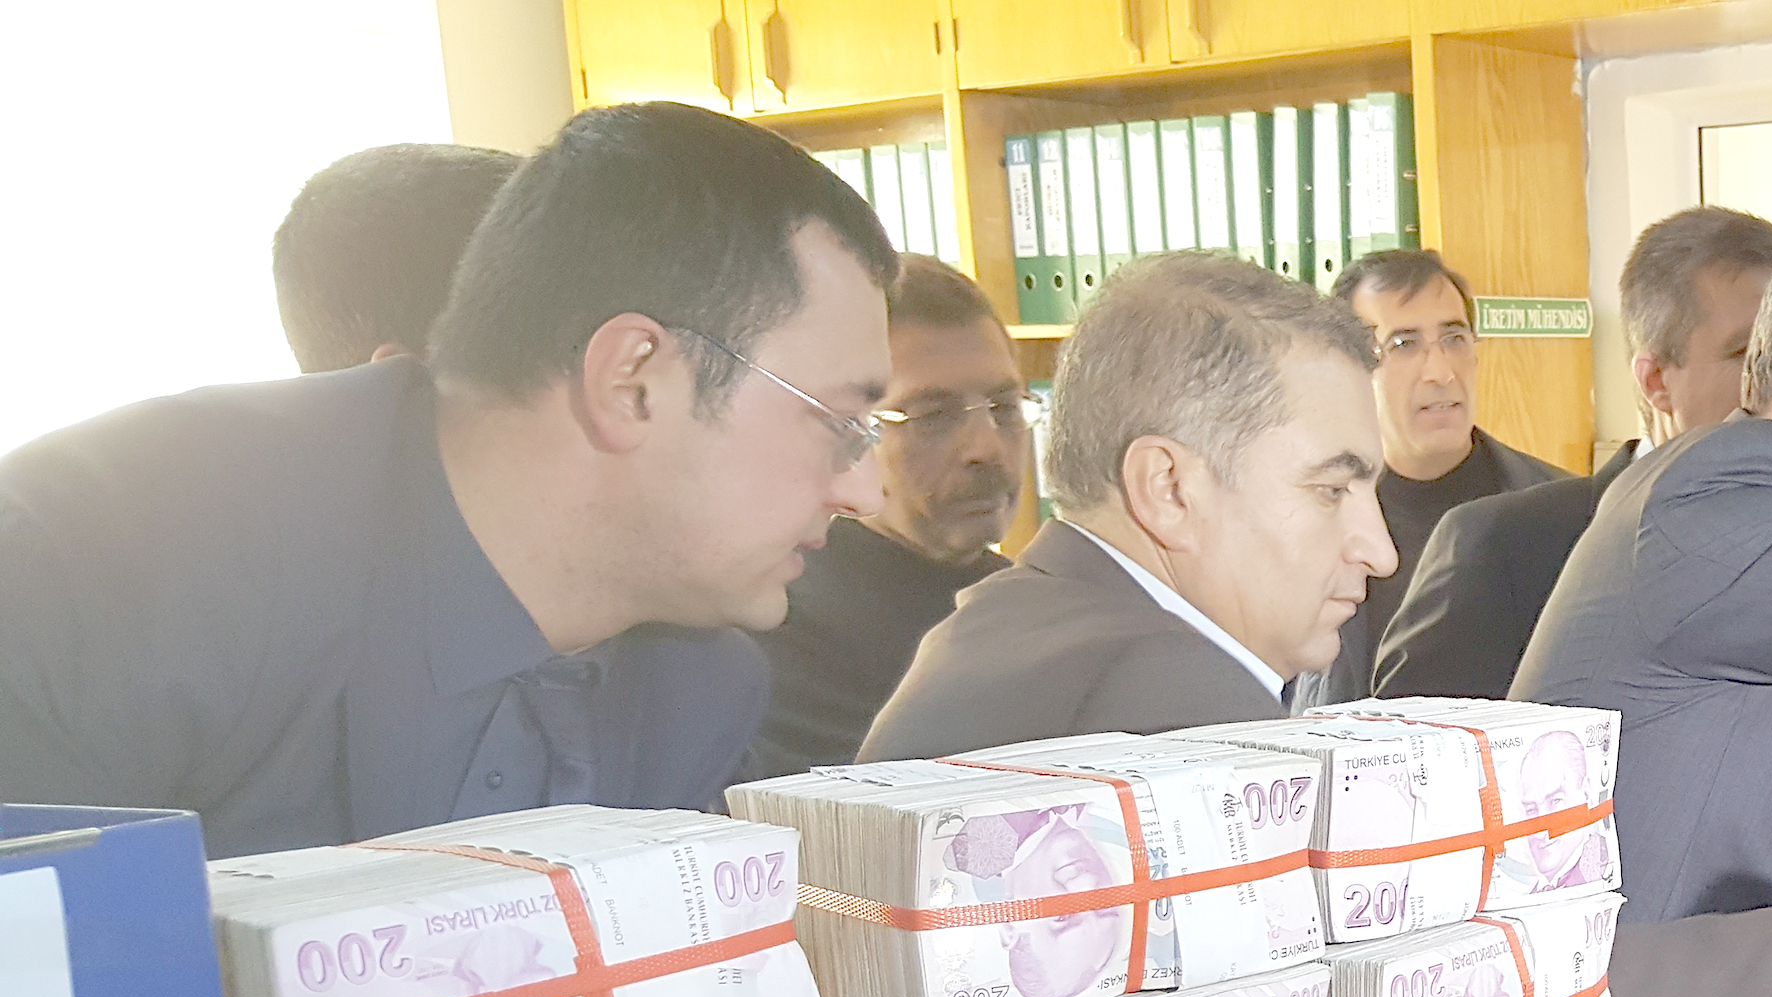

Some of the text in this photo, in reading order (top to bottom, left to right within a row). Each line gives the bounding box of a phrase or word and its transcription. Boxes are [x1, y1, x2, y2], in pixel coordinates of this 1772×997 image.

[1345, 755, 1390, 771] TÜRKİYE
[1243, 776, 1313, 830] 200
[713, 851, 786, 907] 200
[297, 923, 413, 993] 200
